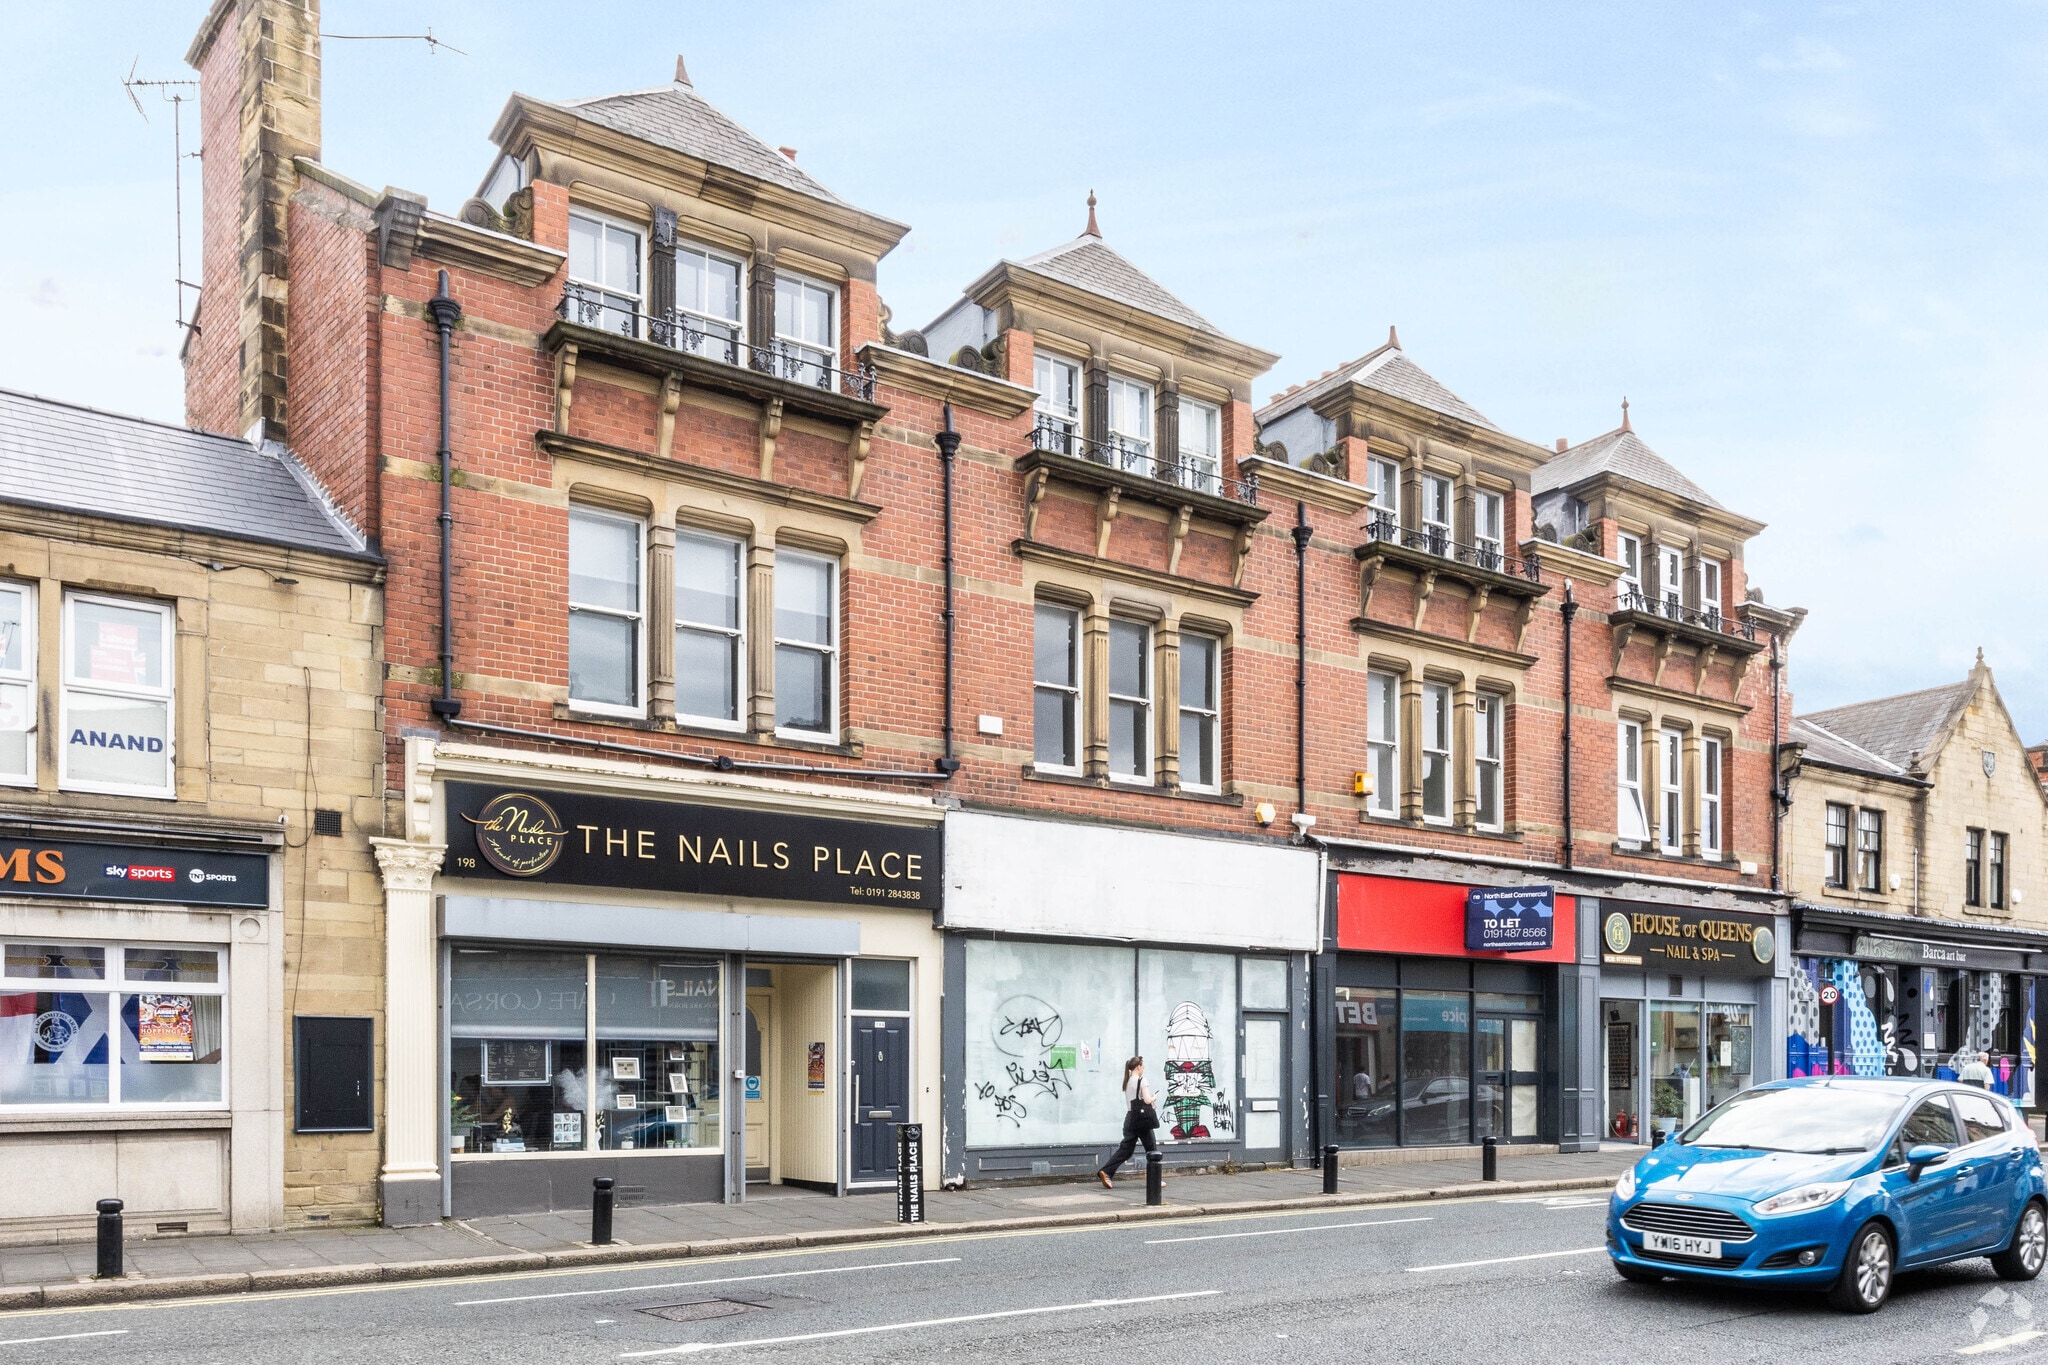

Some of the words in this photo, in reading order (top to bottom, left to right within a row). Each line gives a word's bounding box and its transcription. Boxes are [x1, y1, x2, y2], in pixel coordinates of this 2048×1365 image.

[70, 729, 163, 753] ANAND
[510, 834, 553, 846] PLACE
[577, 825, 656, 859] THE
[679, 835, 790, 870] NAILS
[814, 846, 922, 881] PLACE
[456, 858, 476, 869] 198
[106, 866, 128, 878] sky
[130, 868, 173, 879] sports
[205, 874, 237, 882] SPORTS
[850, 886, 865, 896] Tel:
[866, 887, 885, 897] 0191
[888, 889, 921, 900] 2843838
[1484, 919, 1498, 929] TO
[1500, 918, 1521, 928] LET
[1631, 912, 1681, 937] HOUSE
[1698, 919, 1753, 943] QUEENS
[1483, 929, 1503, 939] 0191
[1504, 928, 1521, 938] 487
[1522, 928, 1547, 938] 8566
[1666, 944, 1691, 960] NAIL
[1692, 947, 1700, 960] &
[1701, 947, 1720, 961] SPA
[1922, 944, 1946, 960] Barca
[1823, 990, 1837, 1000] 20
[909, 1142, 918, 1172] PLACE
[910, 1174, 919, 1202] NAILS
[911, 1204, 919, 1221] THE
[1652, 1234, 1681, 1251] YW16
[1684, 1239, 1712, 1254] HYJ
